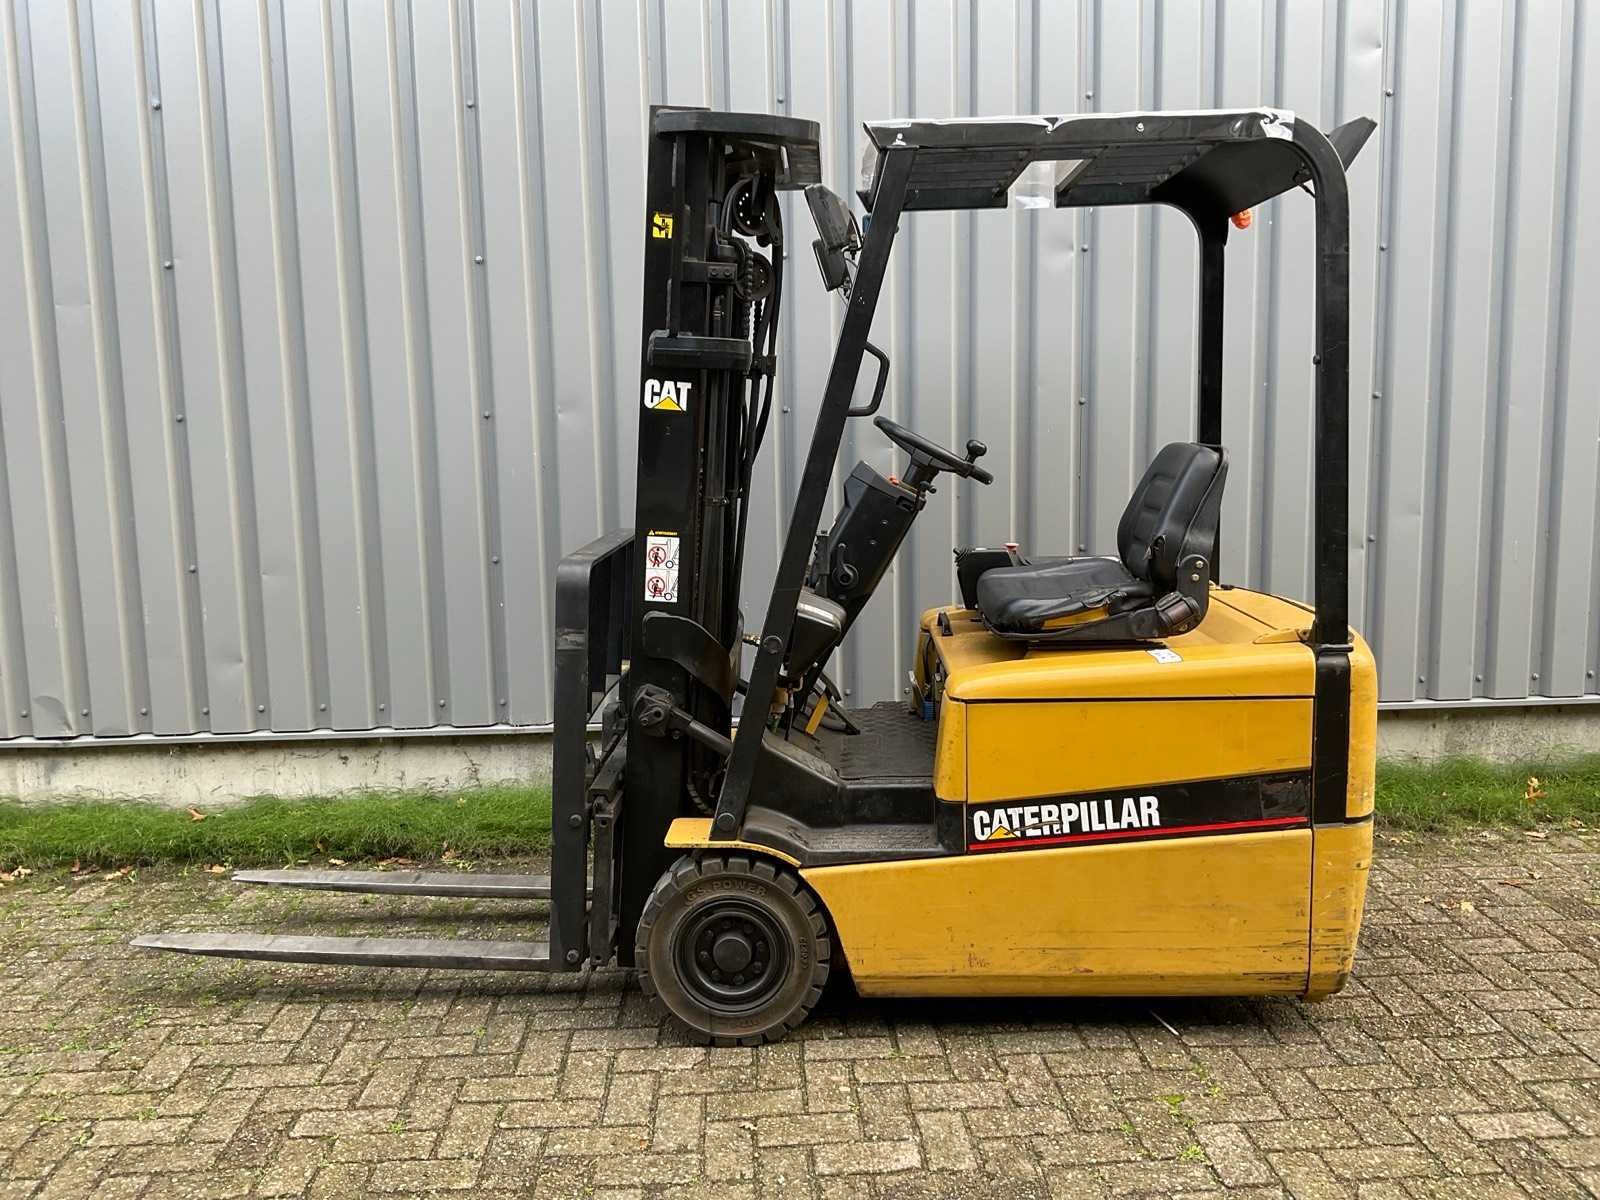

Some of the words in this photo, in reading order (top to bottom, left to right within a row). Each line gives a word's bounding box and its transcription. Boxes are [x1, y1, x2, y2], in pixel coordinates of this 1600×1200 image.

[644, 378, 692, 412] CAT
[973, 795, 1161, 841] CATERPILLAR
[712, 879, 768, 899] POWER
